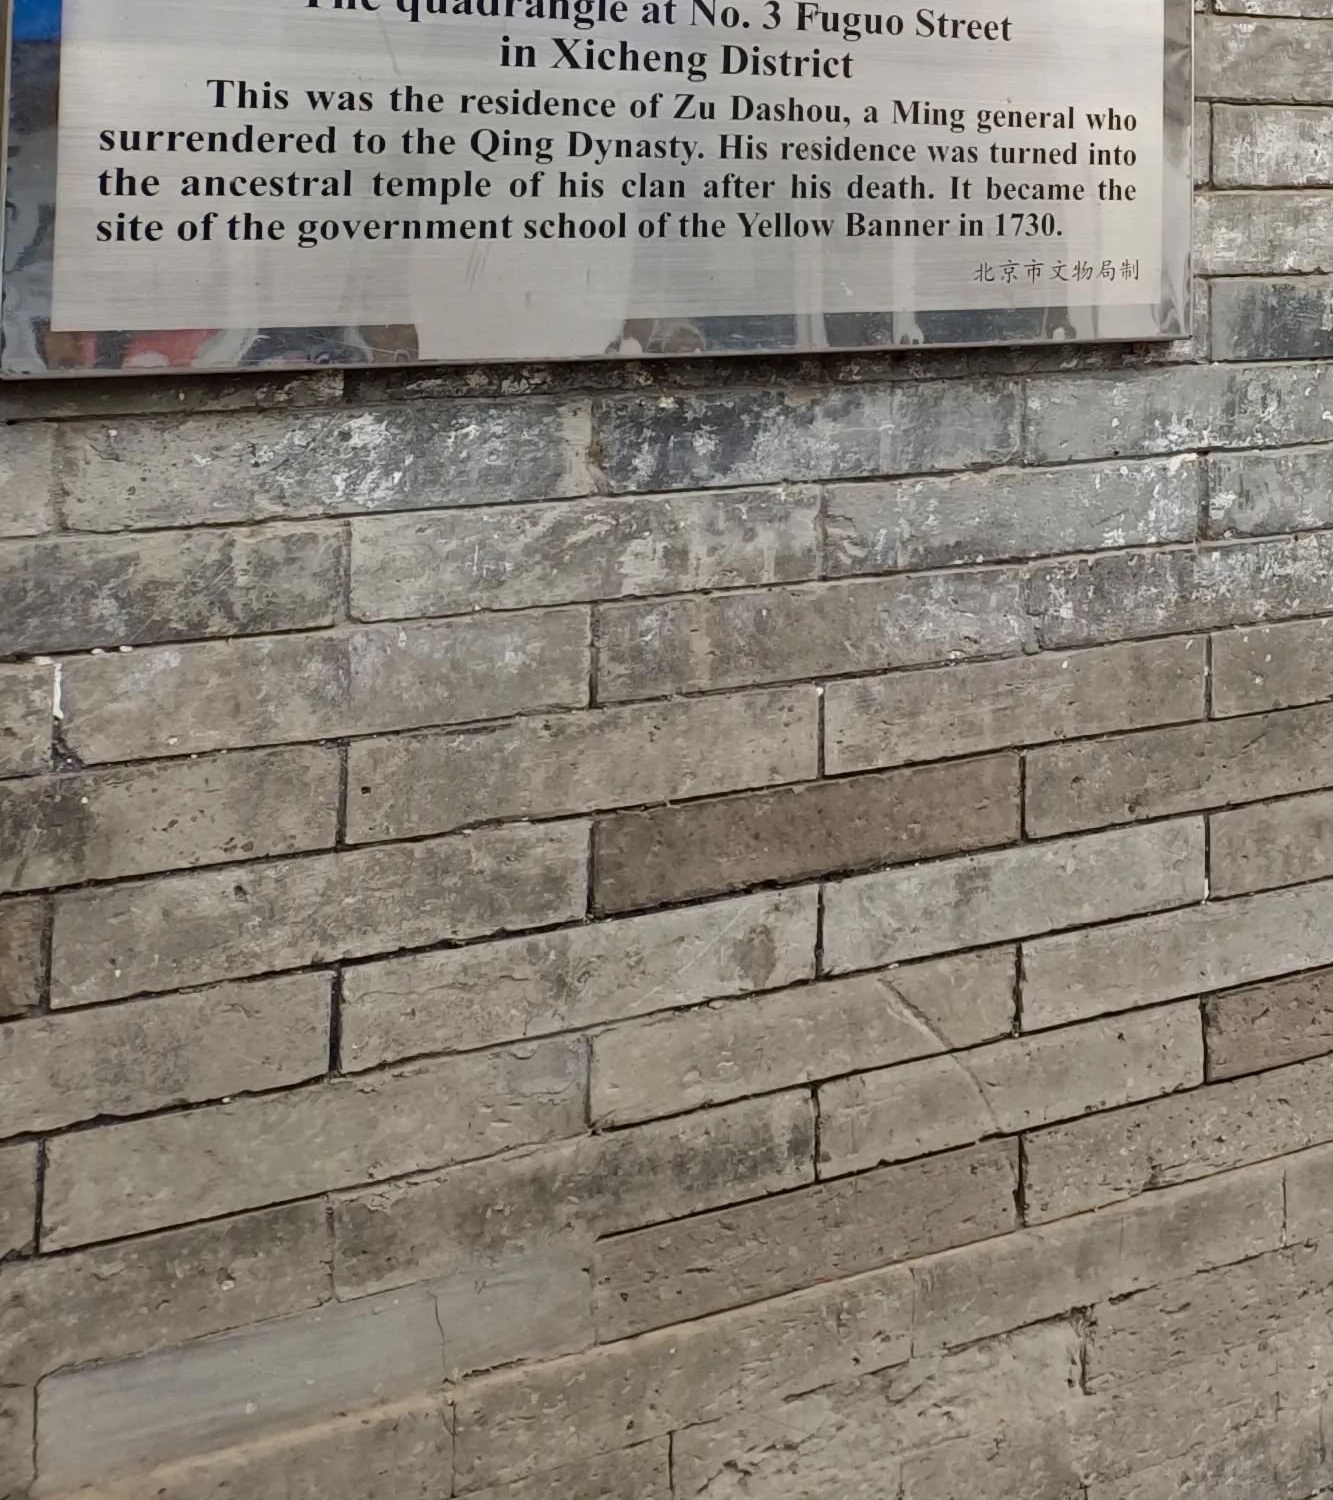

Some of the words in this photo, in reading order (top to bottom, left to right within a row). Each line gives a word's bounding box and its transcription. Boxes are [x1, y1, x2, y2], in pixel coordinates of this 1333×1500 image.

[762, 0, 781, 30] 3
[796, 1, 904, 42] Fuguo
[915, 8, 1013, 42] Street
[500, 35, 536, 68] in
[550, 37, 708, 83] Xicheng
[721, 44, 854, 79] District
[206, 79, 289, 110] This
[305, 90, 374, 112] was
[389, 85, 445, 113] the
[460, 88, 616, 118] residence
[629, 92, 664, 119] of
[673, 93, 715, 120] Zu
[731, 95, 851, 127] Dashou,
[863, 105, 879, 124] a
[892, 99, 966, 134] Ming
[976, 106, 1075, 134] general
[1085, 107, 1137, 132] who
[99, 124, 337, 154] surrendered
[352, 128, 386, 155] to
[401, 127, 456, 155] the
[470, 128, 554, 165] Qing
[568, 131, 704, 167] Dynasty.
[719, 134, 768, 160] His
[781, 135, 916, 162] residence
[927, 145, 978, 164] was
[989, 141, 1077, 165] turned
[1089, 142, 1137, 167] into
[97, 167, 161, 197] the
[180, 169, 352, 197] ancestral
[372, 170, 492, 205] temple
[509, 170, 545, 198] of
[559, 171, 604, 198] his
[621, 172, 686, 199] clan
[703, 172, 776, 199] after
[791, 173, 831, 199] his
[847, 174, 935, 200] death.
[951, 176, 973, 200] It
[986, 176, 1085, 201] became
[1097, 178, 1137, 202] the
[96, 212, 164, 242] site
[177, 211, 219, 242] of
[226, 212, 285, 241] the
[297, 214, 513, 249] government
[523, 212, 627, 240] school
[638, 211, 672, 239] of
[678, 212, 726, 238] the
[737, 212, 835, 238] Yellow
[846, 212, 951, 237] Banner
[959, 212, 984, 237] in
[996, 212, 1063, 237] 1730.
[973, 258, 1141, 284] 北京市文物局制
